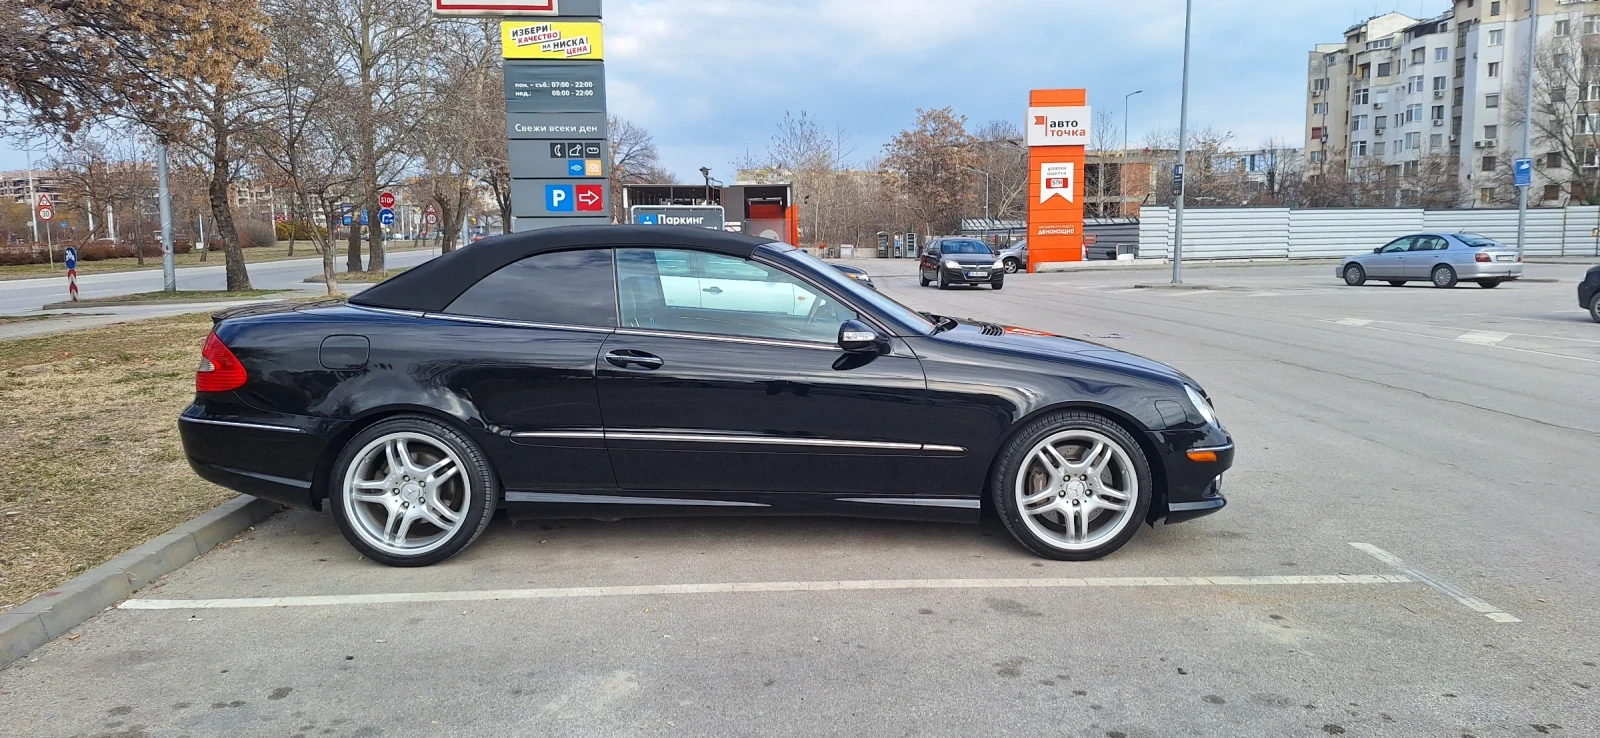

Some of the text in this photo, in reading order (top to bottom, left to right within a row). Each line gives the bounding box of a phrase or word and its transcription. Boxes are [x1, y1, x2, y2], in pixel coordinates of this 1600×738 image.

[512, 25, 548, 38] ИЗБЕРИ
[517, 32, 558, 44] КАЧЕСТВО
[553, 37, 585, 49] НИСКА
[566, 45, 588, 55] ЦЕНА
[515, 123, 546, 132] Свежи
[579, 125, 598, 133] ден
[1049, 119, 1078, 128] авто
[1050, 128, 1086, 138] точка
[657, 214, 704, 225] Паркинг
